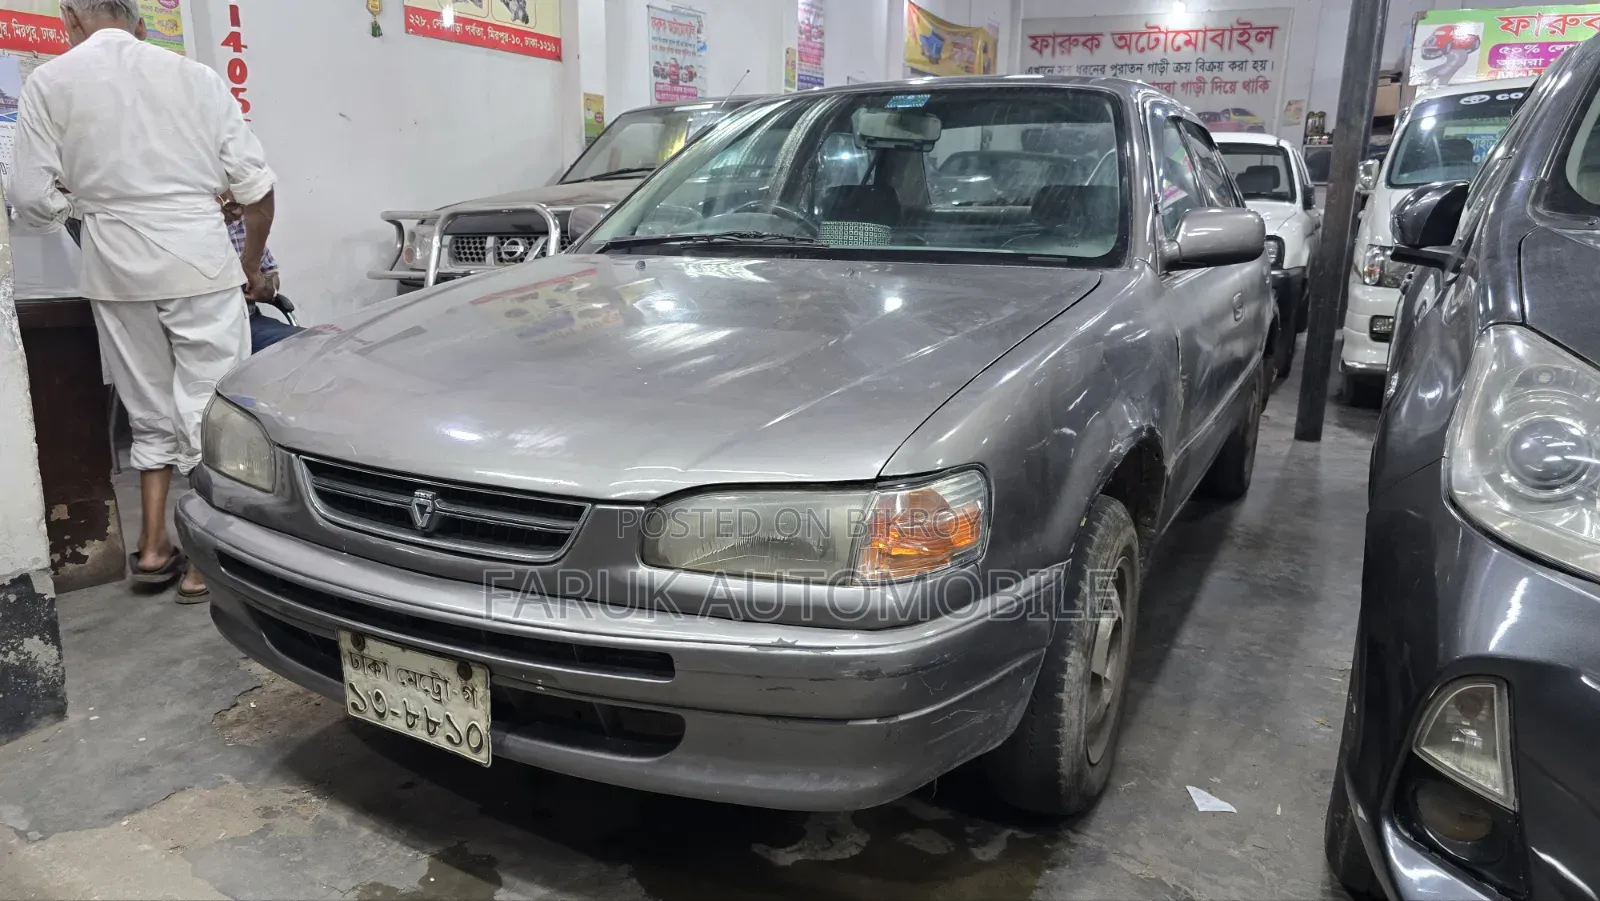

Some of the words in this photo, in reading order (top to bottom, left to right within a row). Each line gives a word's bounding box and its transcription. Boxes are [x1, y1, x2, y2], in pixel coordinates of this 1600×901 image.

[1028, 32, 1104, 58] ফারুক
[1110, 19, 1279, 54] অটোমোবাইল
[220, 4, 252, 122] 1405
[1110, 63, 1143, 77] পুরাতন
[1195, 57, 1224, 73] বিক্রয়
[1228, 60, 1249, 73] করা
[1242, 75, 1271, 95] থাকি
[347, 650, 392, 682] ঢাকা
